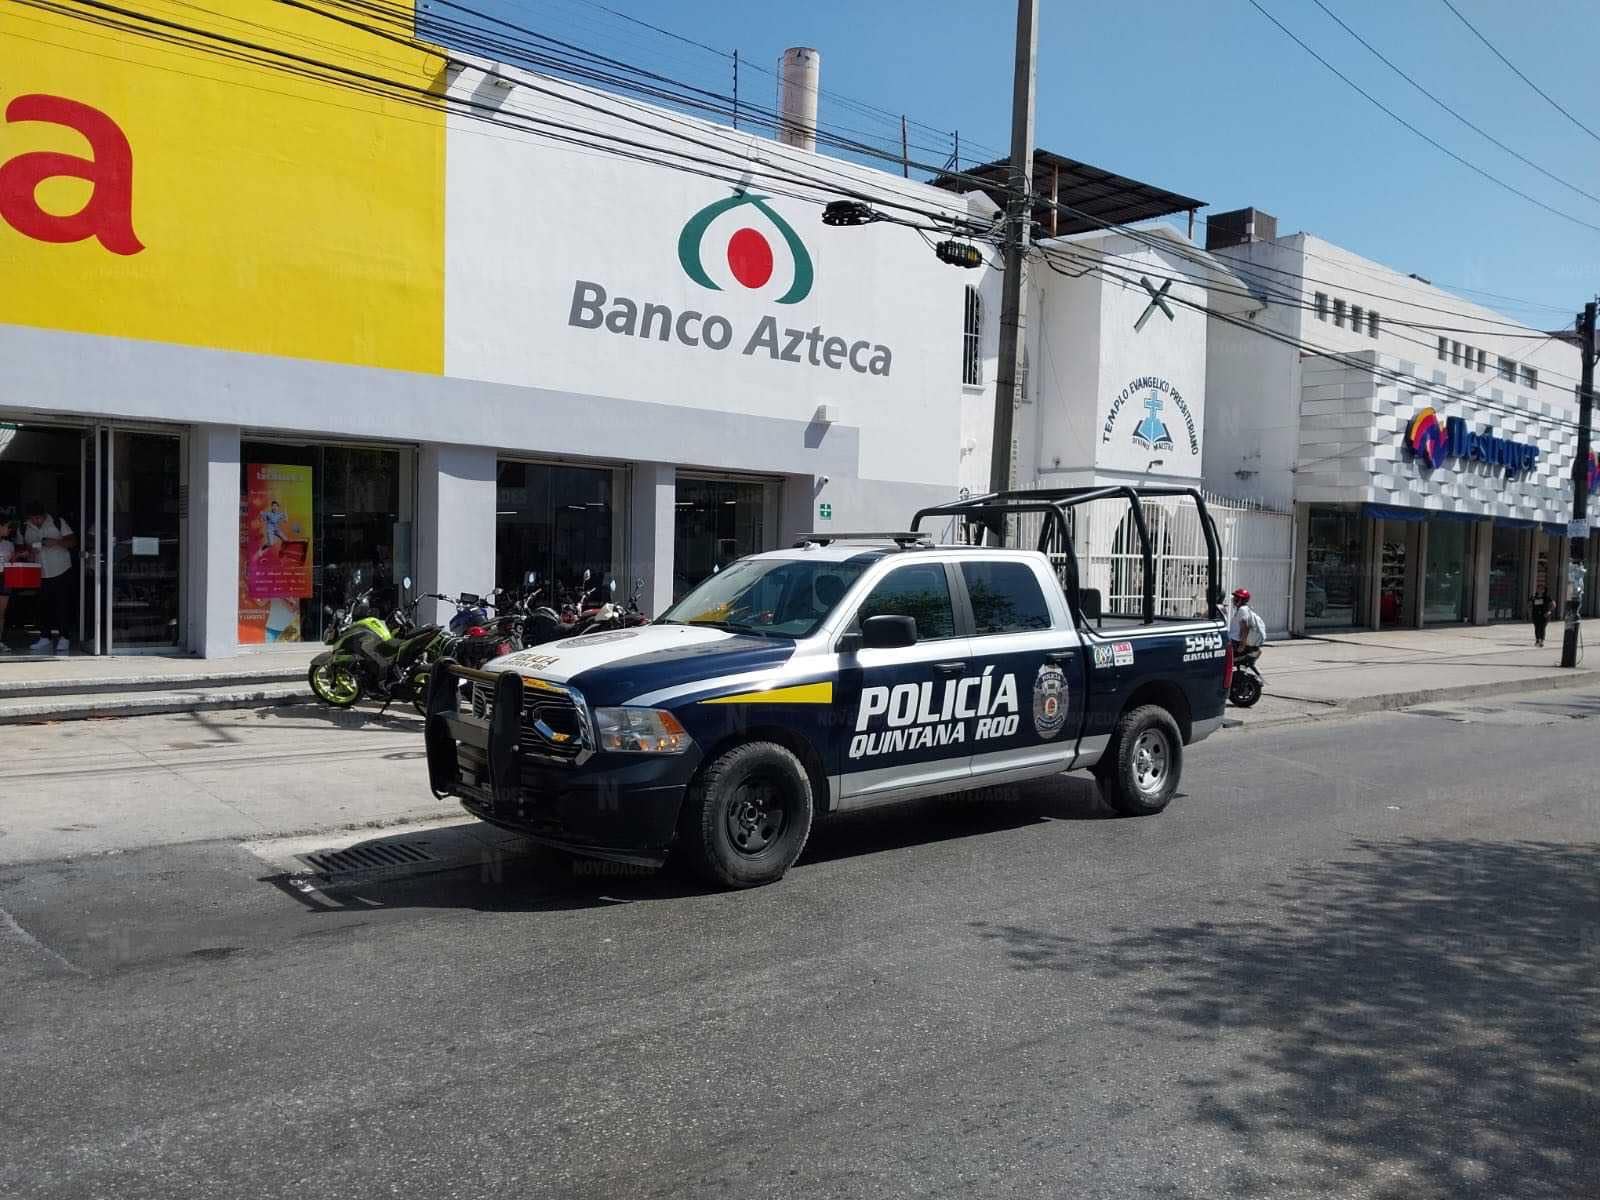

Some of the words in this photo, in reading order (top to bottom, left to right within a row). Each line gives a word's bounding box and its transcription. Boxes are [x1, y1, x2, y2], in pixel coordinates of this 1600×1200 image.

[568, 279, 733, 351] Banco
[742, 315, 893, 377] Azteca
[1102, 388, 1129, 444] TEMPLO
[1169, 386, 1199, 456] PRESBITERIANO
[1185, 633, 1223, 653] 5949
[855, 665, 1019, 732] POLICÍA
[849, 721, 965, 760] QUINTANA
[975, 714, 1019, 740] ROO
